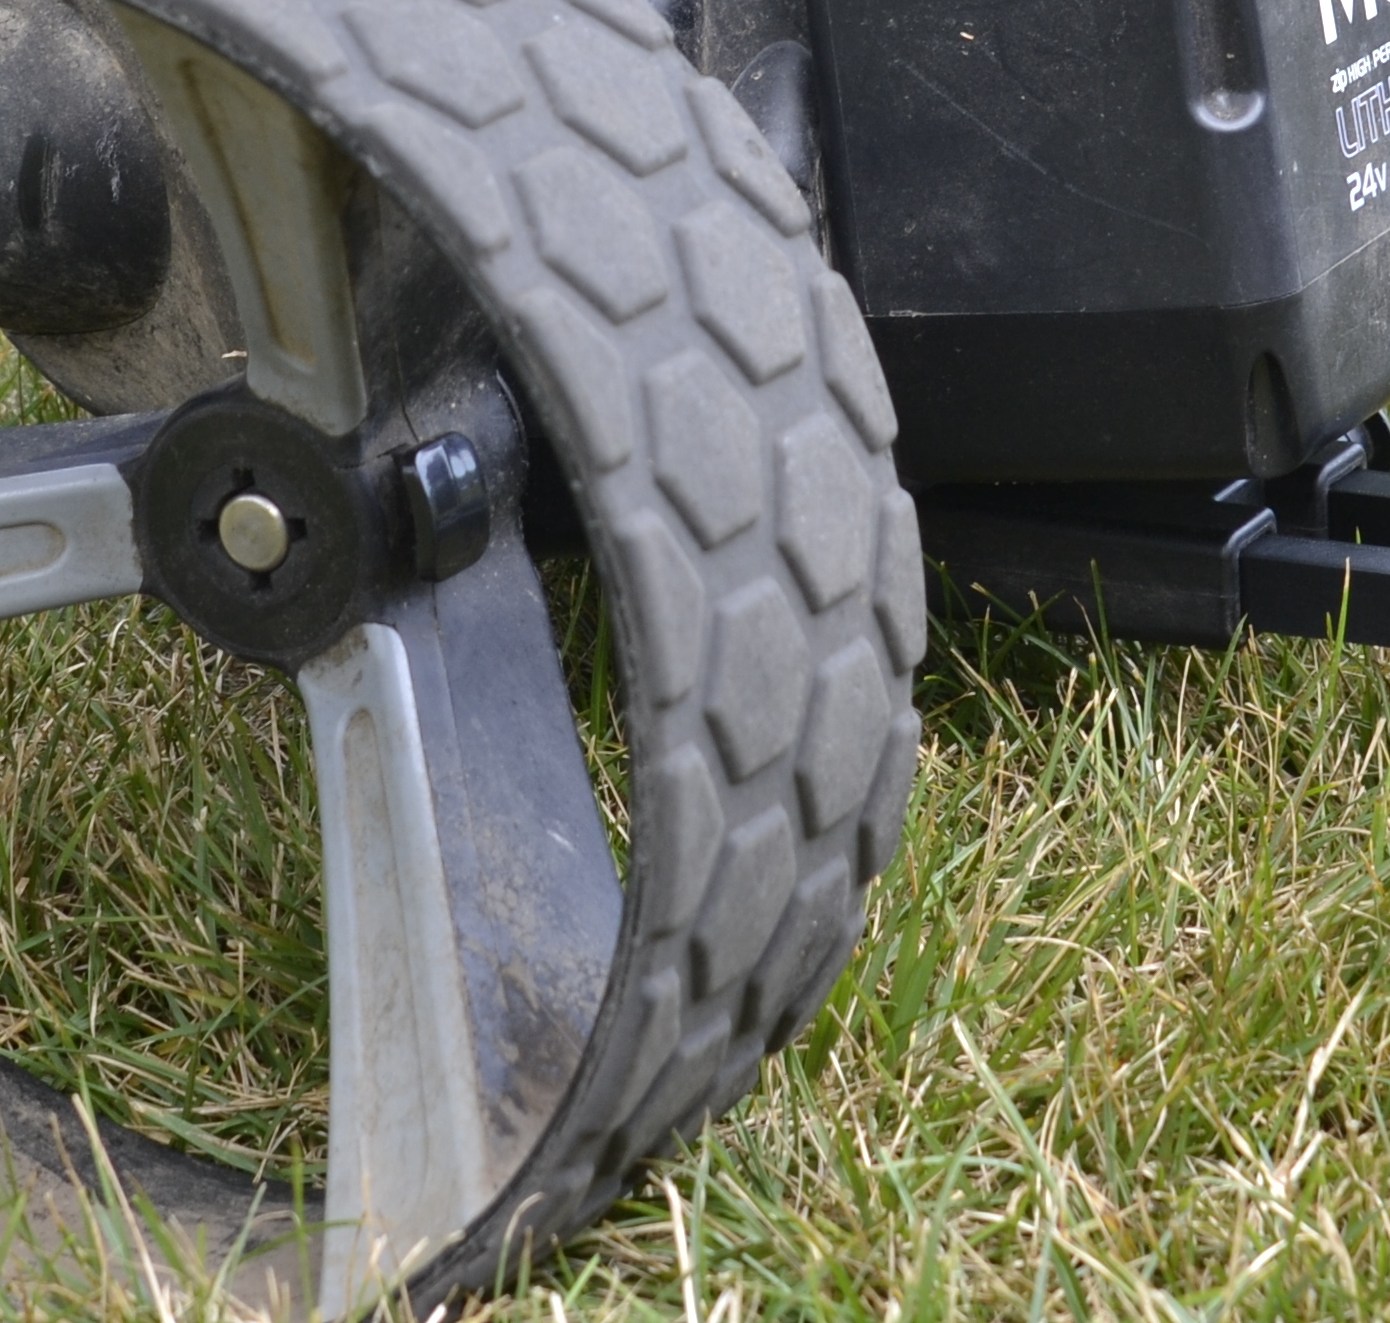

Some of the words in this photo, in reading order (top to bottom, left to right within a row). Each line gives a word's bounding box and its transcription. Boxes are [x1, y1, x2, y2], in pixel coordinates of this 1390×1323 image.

[1330, 68, 1348, 94] zip
[1347, 54, 1372, 84] HIGH
[1346, 162, 1387, 212] 24v
